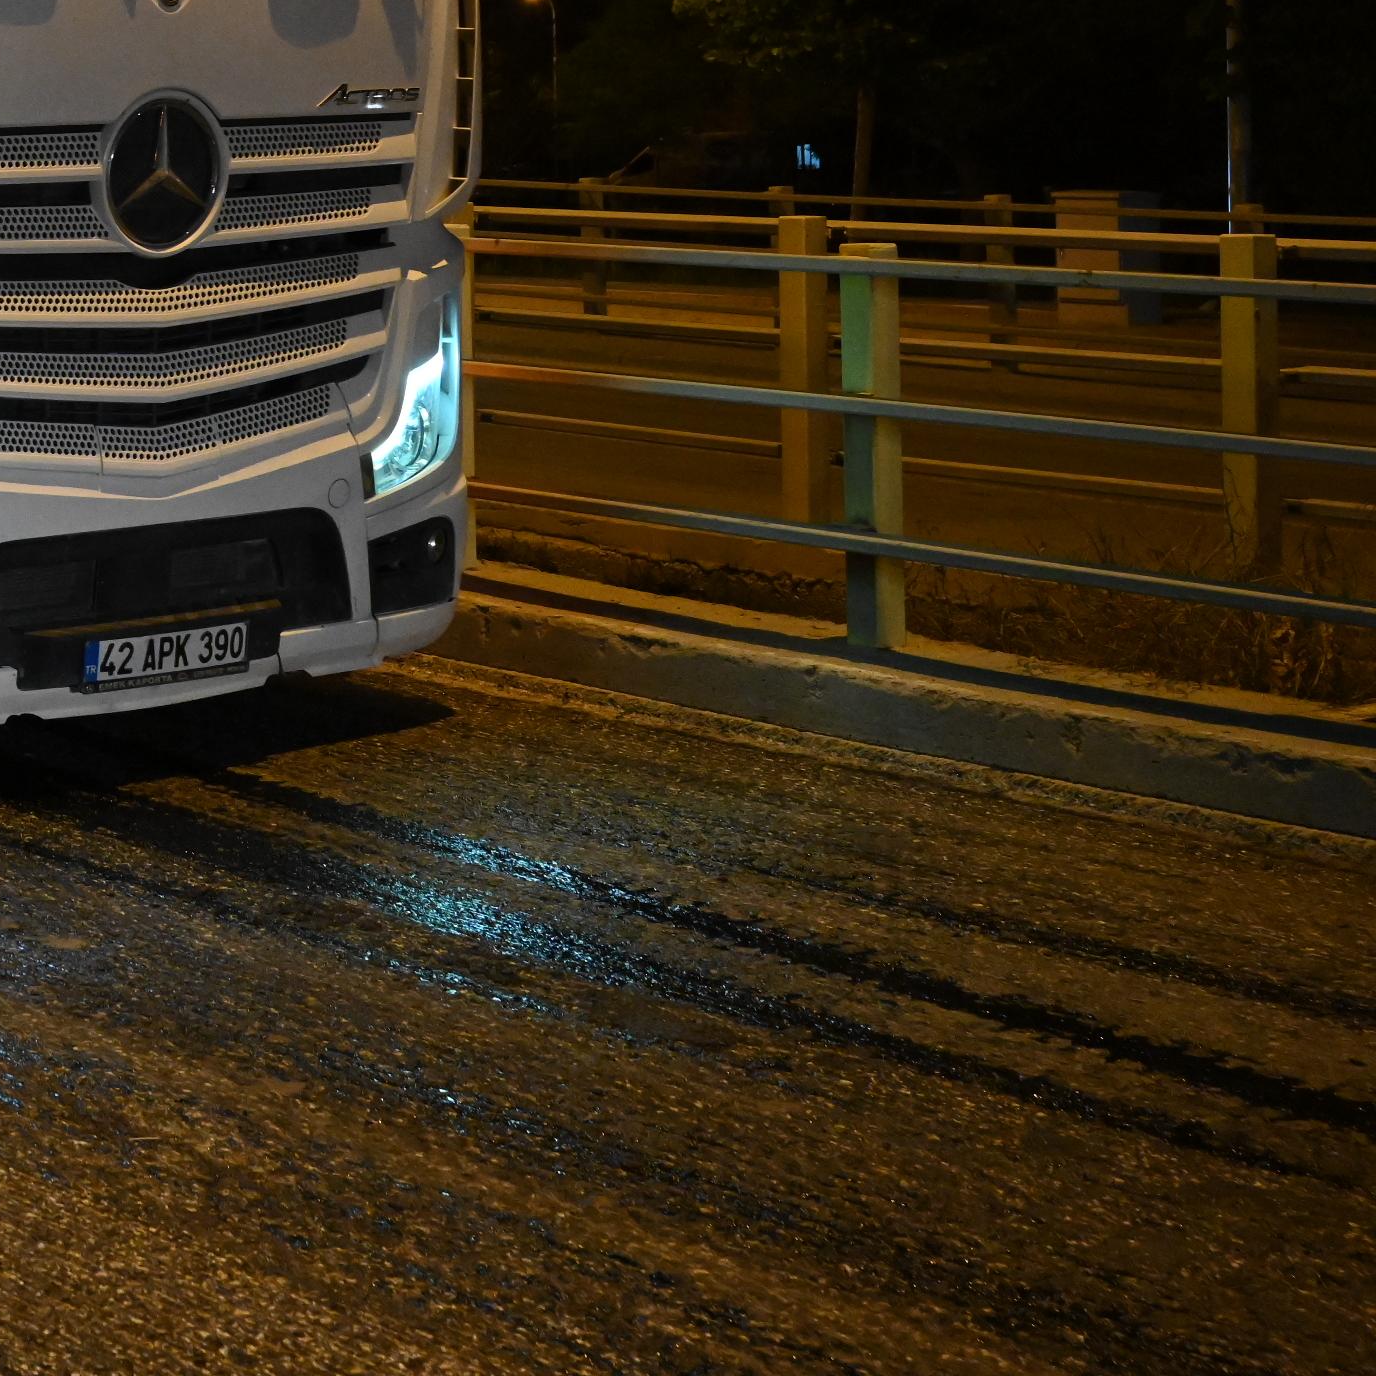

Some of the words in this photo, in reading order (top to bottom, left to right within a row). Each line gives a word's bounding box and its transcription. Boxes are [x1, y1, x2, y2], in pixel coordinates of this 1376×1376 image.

[85, 664, 97, 675] TR
[99, 641, 135, 677] 42
[142, 633, 192, 672] APK
[198, 626, 244, 664] 390
